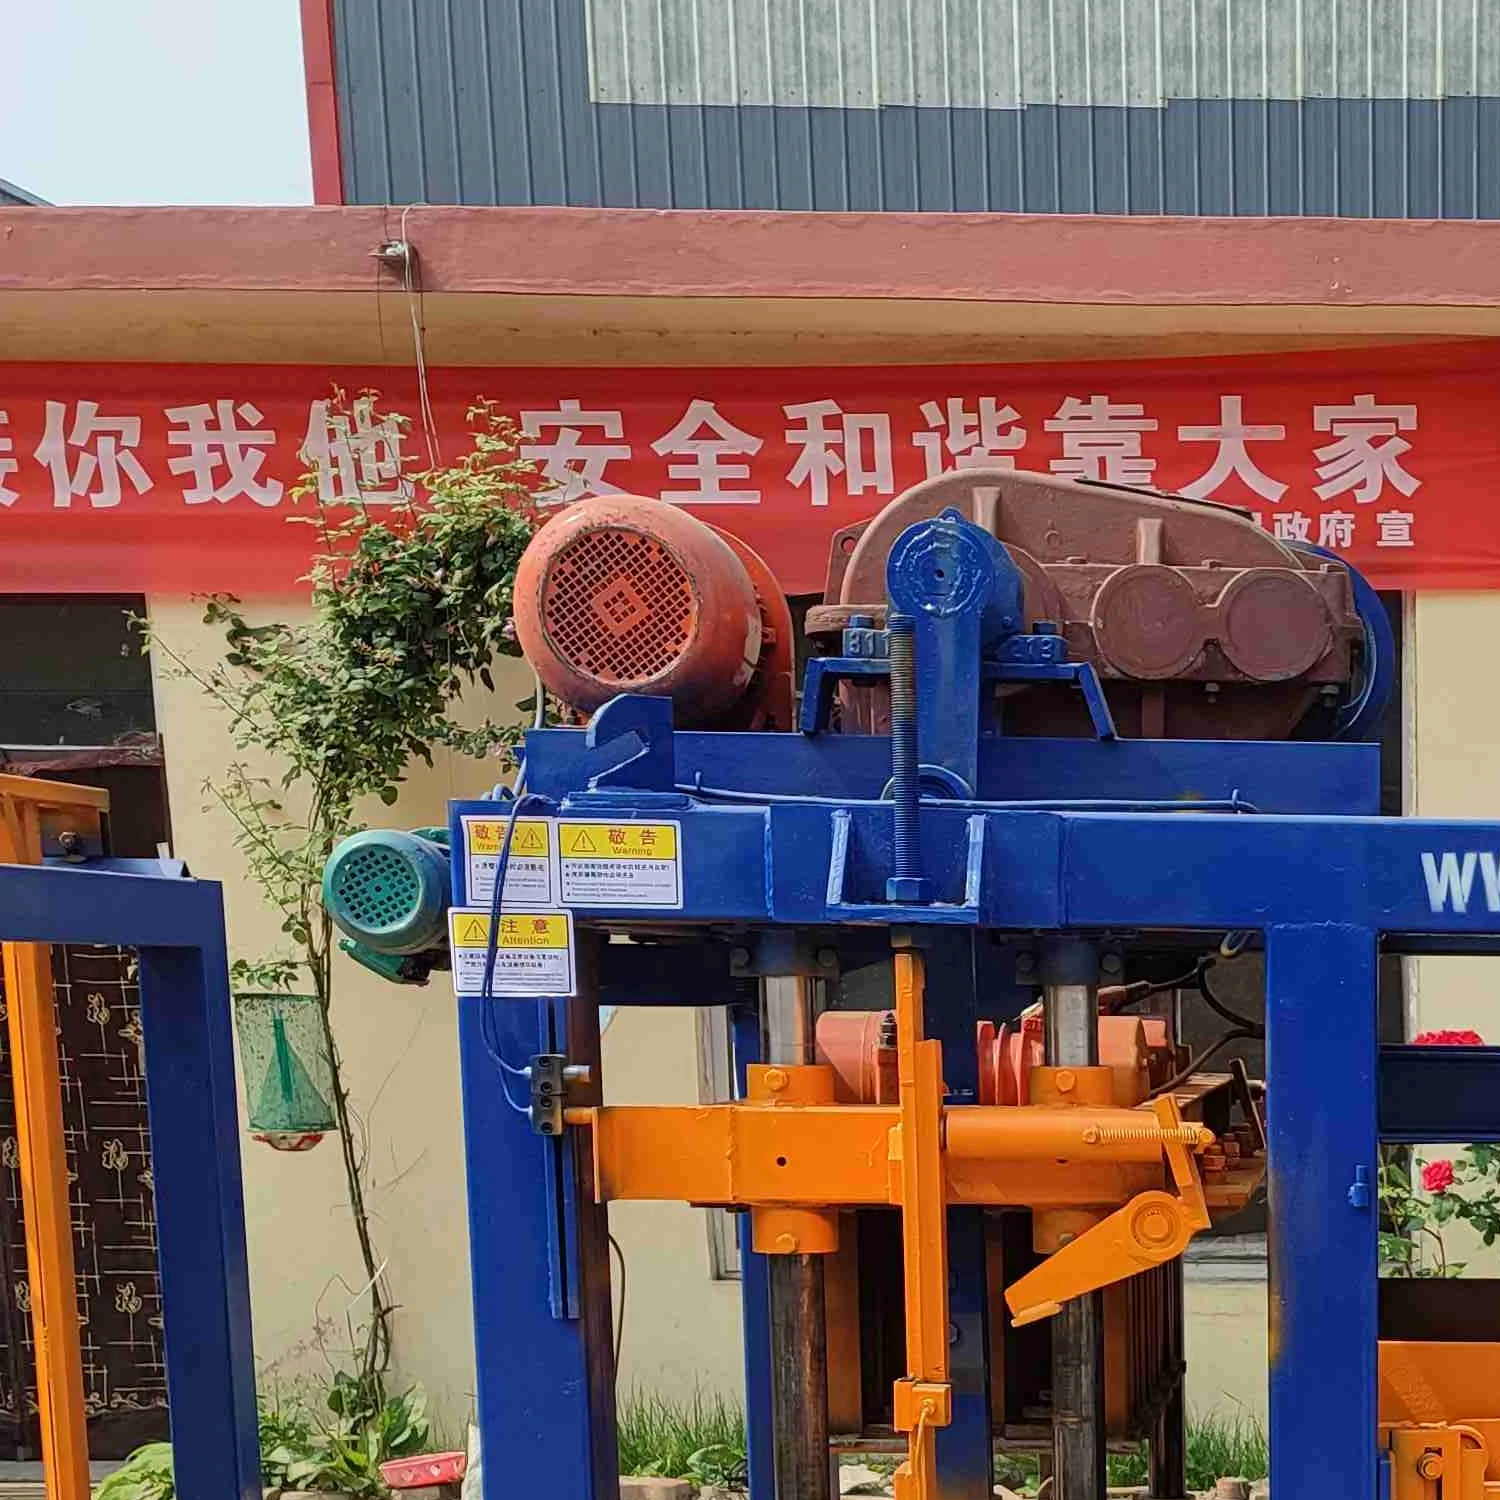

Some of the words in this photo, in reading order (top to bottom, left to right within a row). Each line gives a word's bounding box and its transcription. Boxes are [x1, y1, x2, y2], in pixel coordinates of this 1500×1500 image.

[1251, 509, 1355, 548] 政府
[608, 828, 657, 847] 敬告
[612, 846, 653, 857] Warning
[502, 918, 550, 935] 注意
[502, 935, 550, 946] Attention
